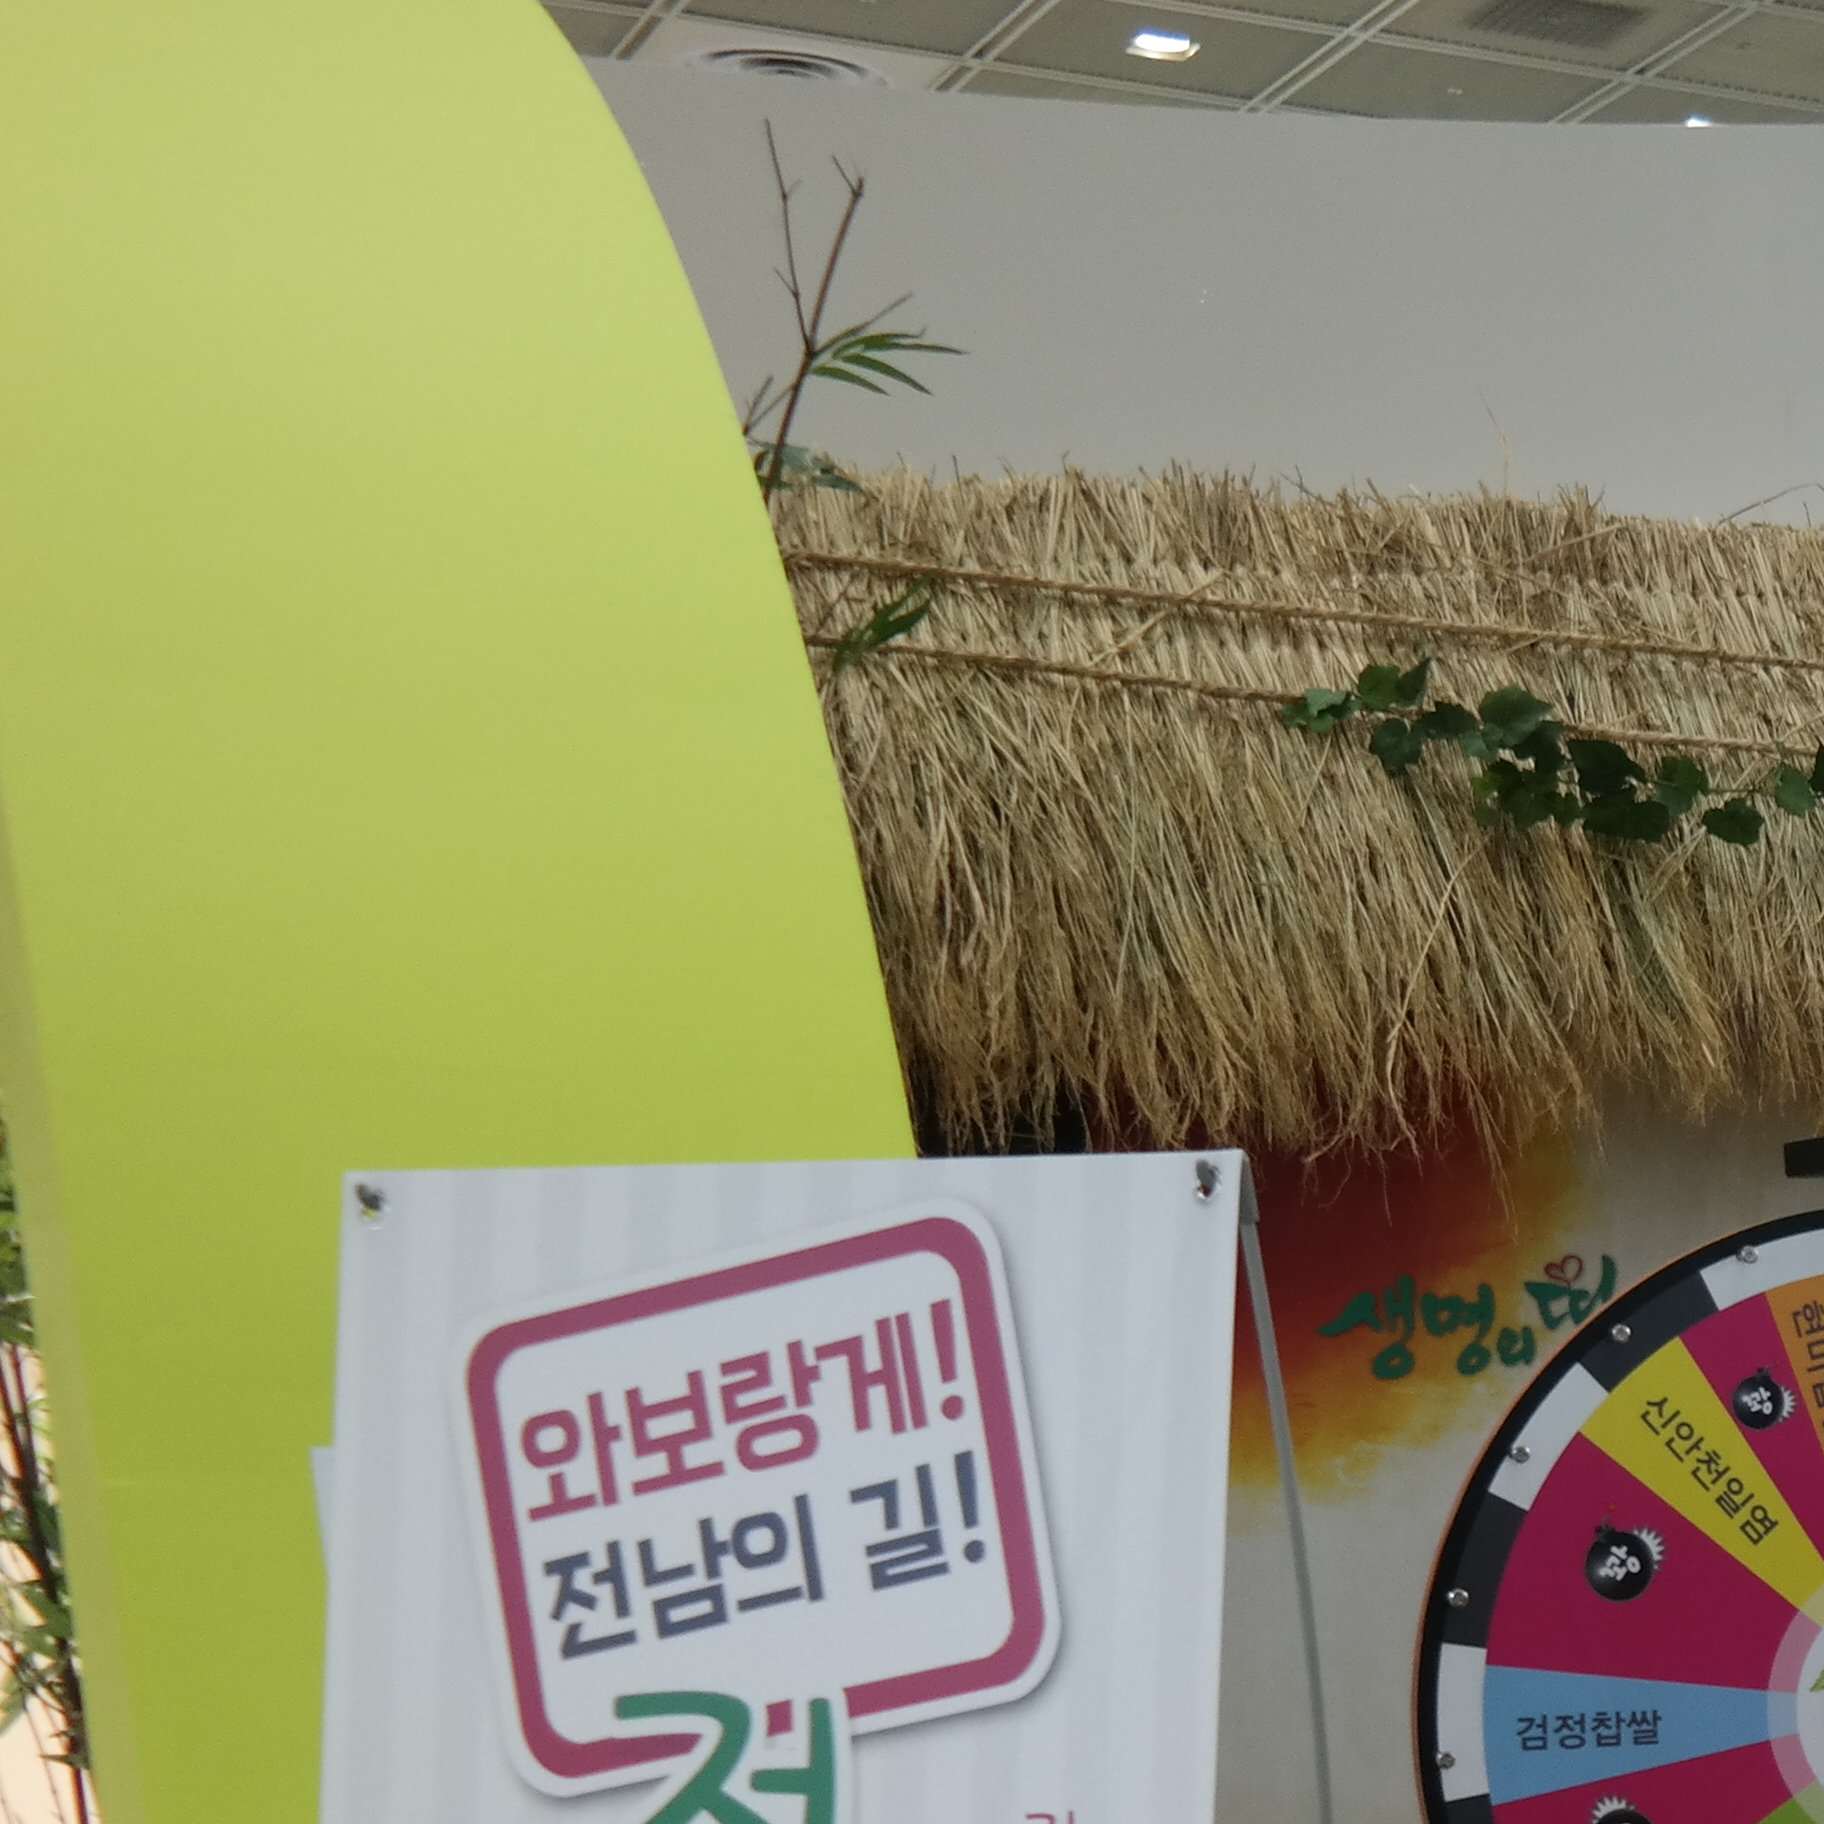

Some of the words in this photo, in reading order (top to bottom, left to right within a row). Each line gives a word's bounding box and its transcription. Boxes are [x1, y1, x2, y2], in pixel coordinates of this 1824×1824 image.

[1316, 1273, 1537, 1381] 생명의
[517, 1299, 969, 1525] 와보랑게!
[1640, 1393, 1781, 1546] 신안천일염
[541, 1494, 825, 1662] 전남의
[848, 1449, 988, 1593] 길!
[1514, 1709, 1665, 1752] 검정찹쌀
